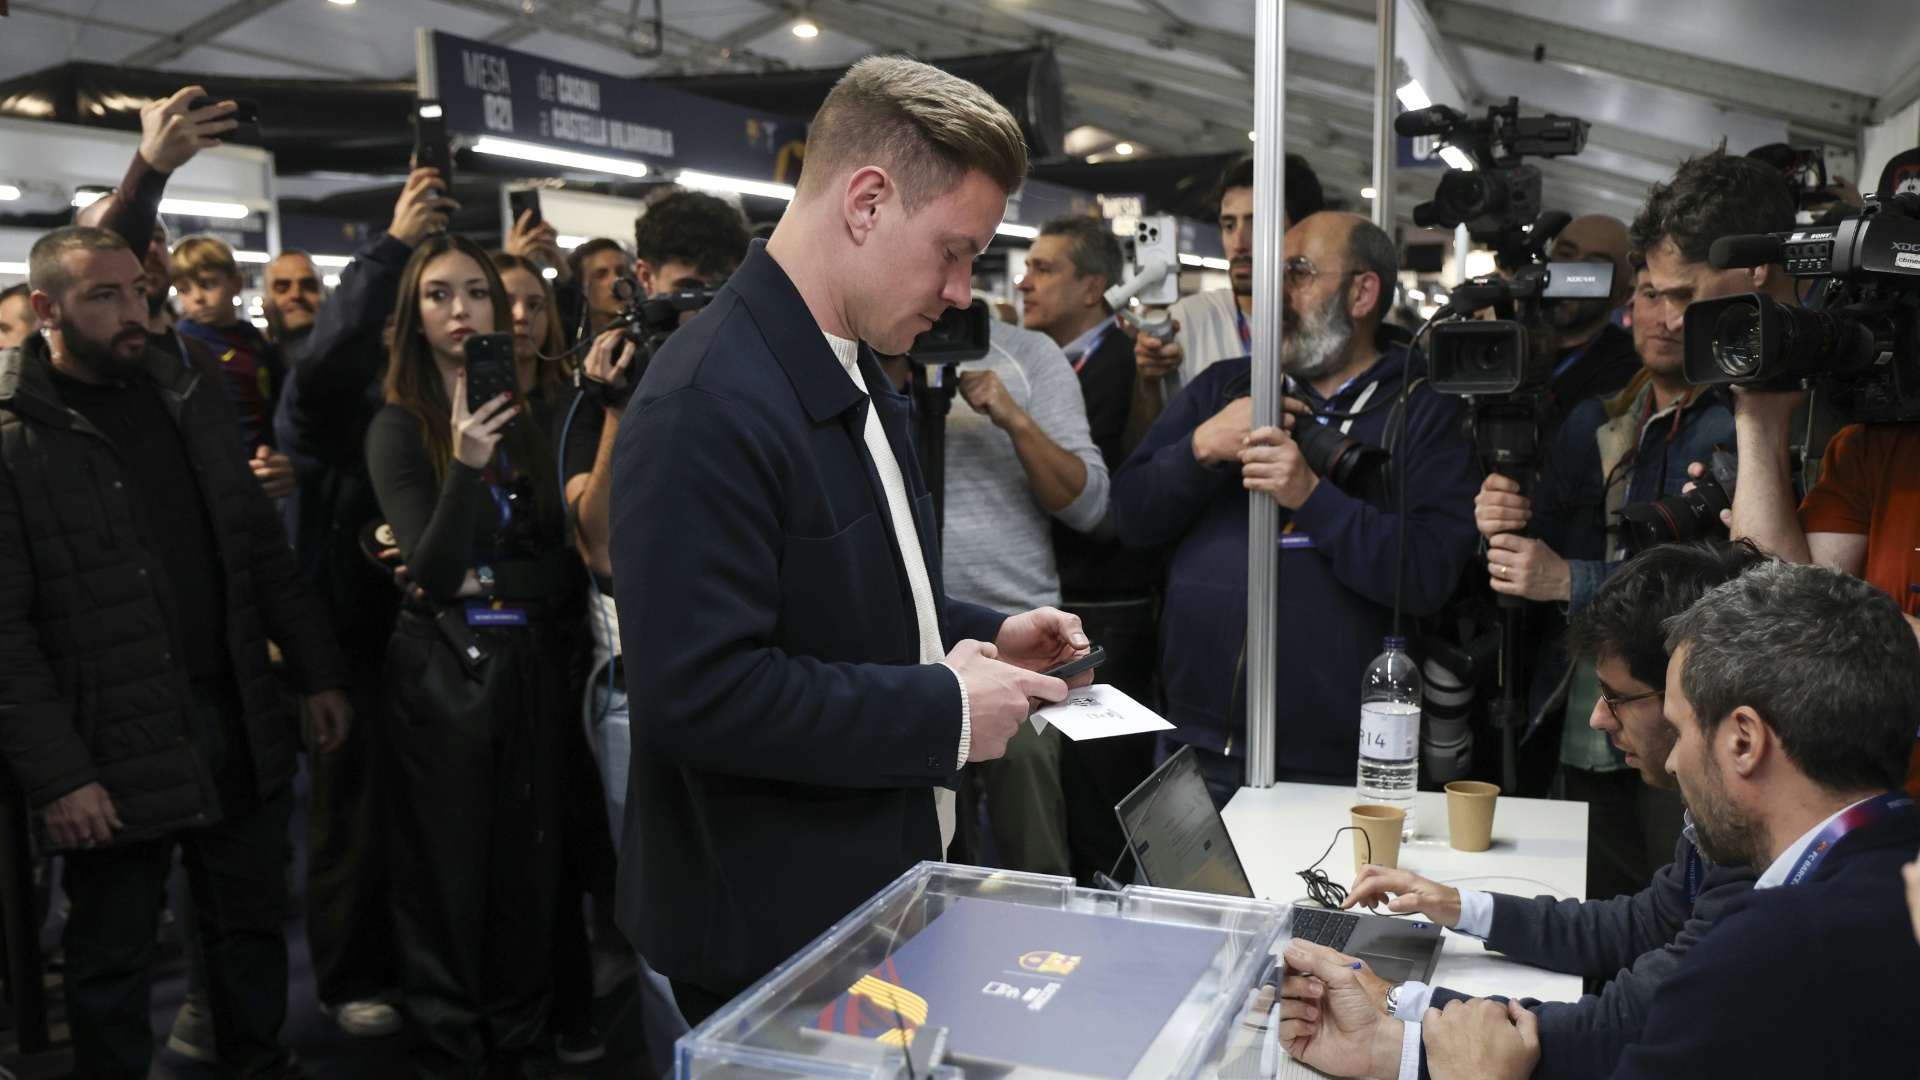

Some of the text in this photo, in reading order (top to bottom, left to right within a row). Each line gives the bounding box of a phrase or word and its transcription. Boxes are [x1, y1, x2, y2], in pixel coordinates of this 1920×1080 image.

[462, 50, 512, 93] MESA
[1890, 241, 1920, 251] XDC
[1808, 850, 1818, 861] FC
